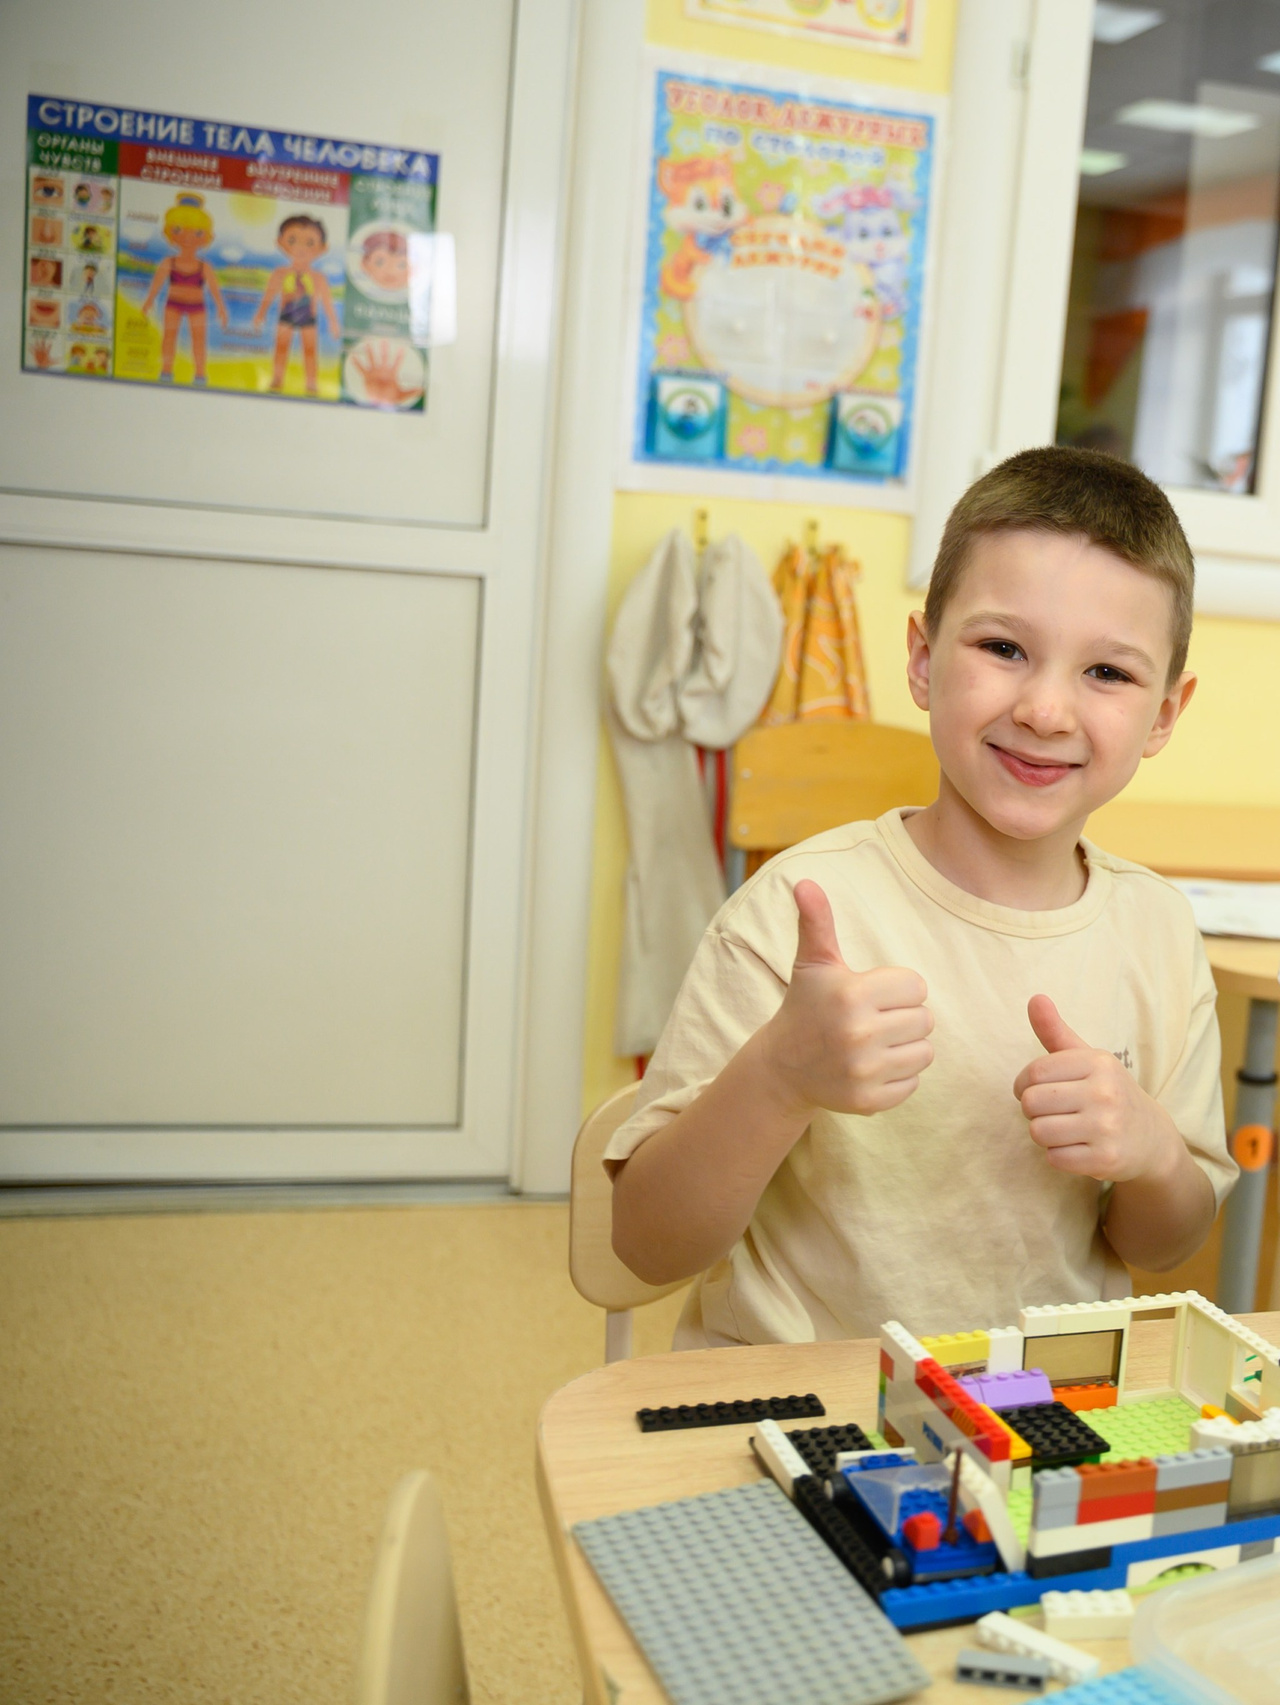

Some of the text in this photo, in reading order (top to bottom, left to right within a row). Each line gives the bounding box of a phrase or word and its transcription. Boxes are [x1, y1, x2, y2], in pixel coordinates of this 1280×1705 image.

[37, 132, 105, 157] ОРГАНЫ
[38, 101, 431, 178] СТРОЕНИЕ ТЕЛА ЧЕЛОВЕКА
[40, 150, 101, 172] ЧУВСТВ
